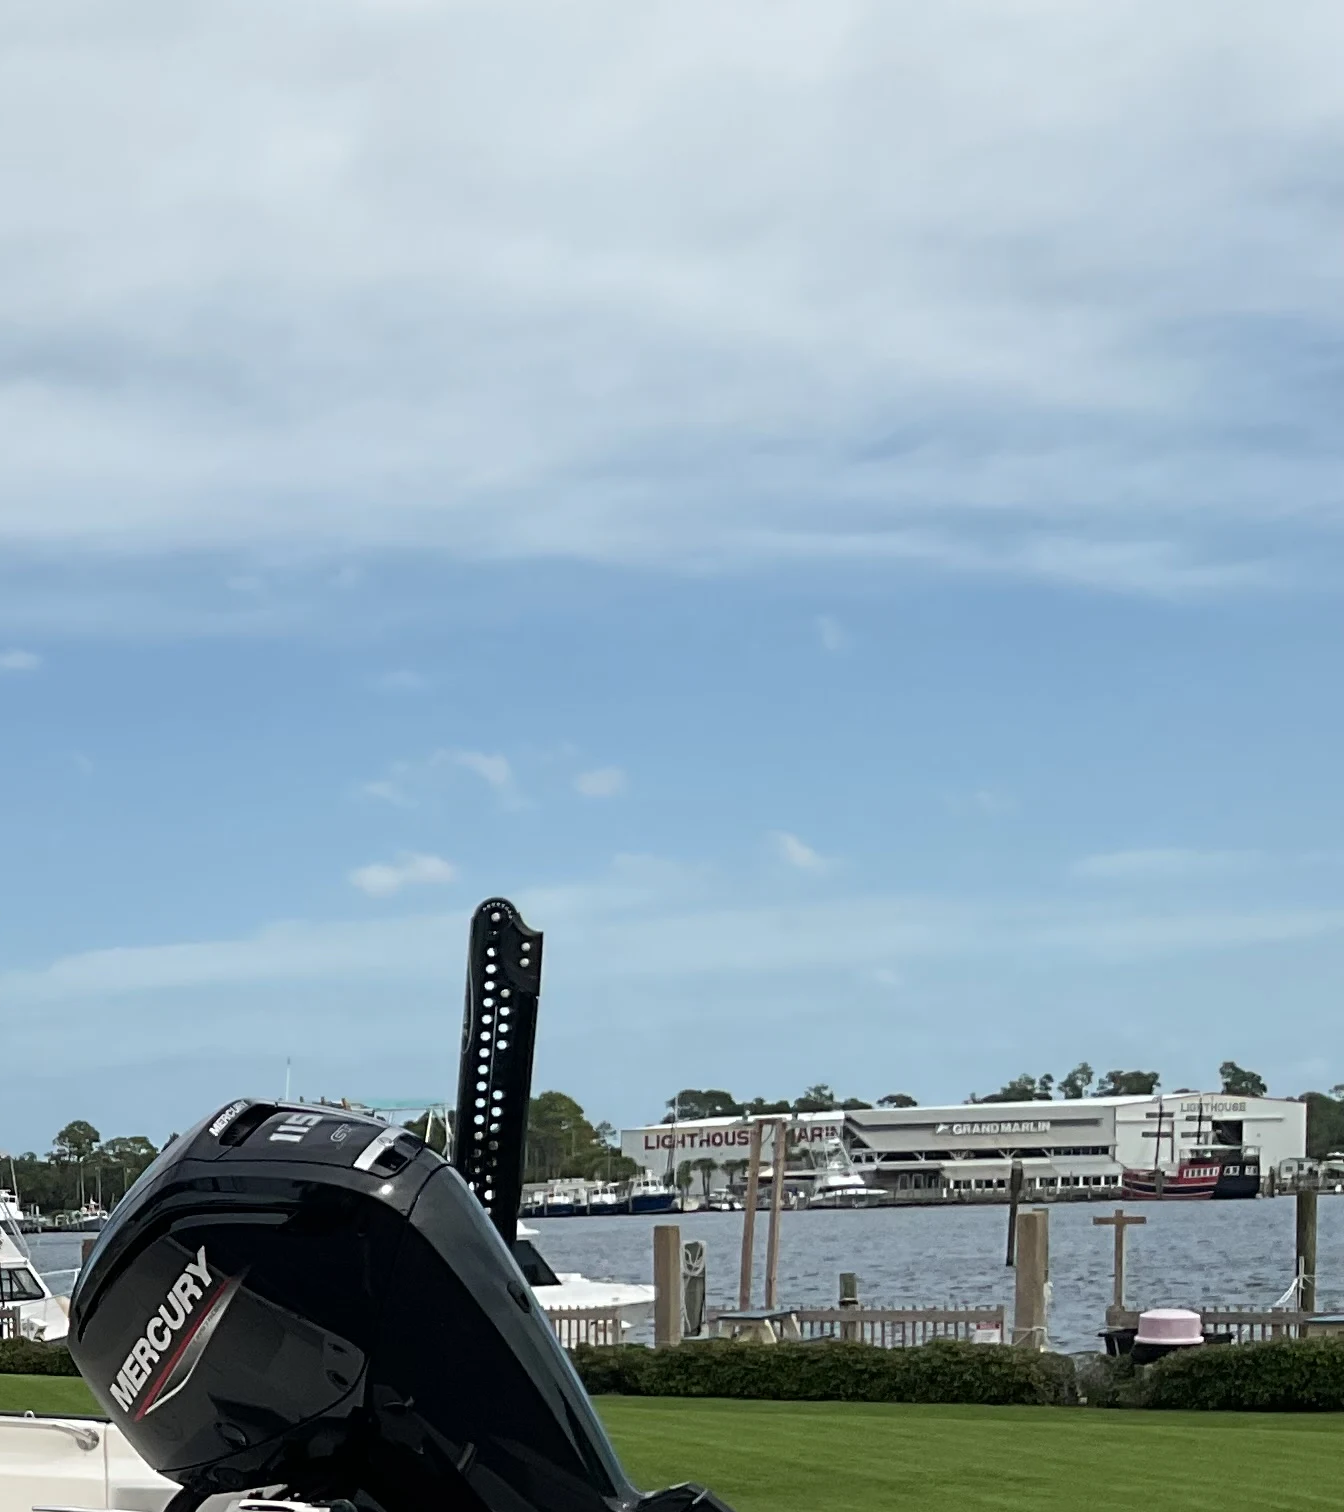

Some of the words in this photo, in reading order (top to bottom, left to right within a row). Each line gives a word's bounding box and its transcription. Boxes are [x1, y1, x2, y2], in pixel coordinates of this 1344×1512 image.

[209, 1100, 248, 1137] MERCURY
[269, 1113, 324, 1143] 115
[644, 1129, 758, 1150] LIGHTHOUS
[109, 1245, 213, 1413] MERCURY
